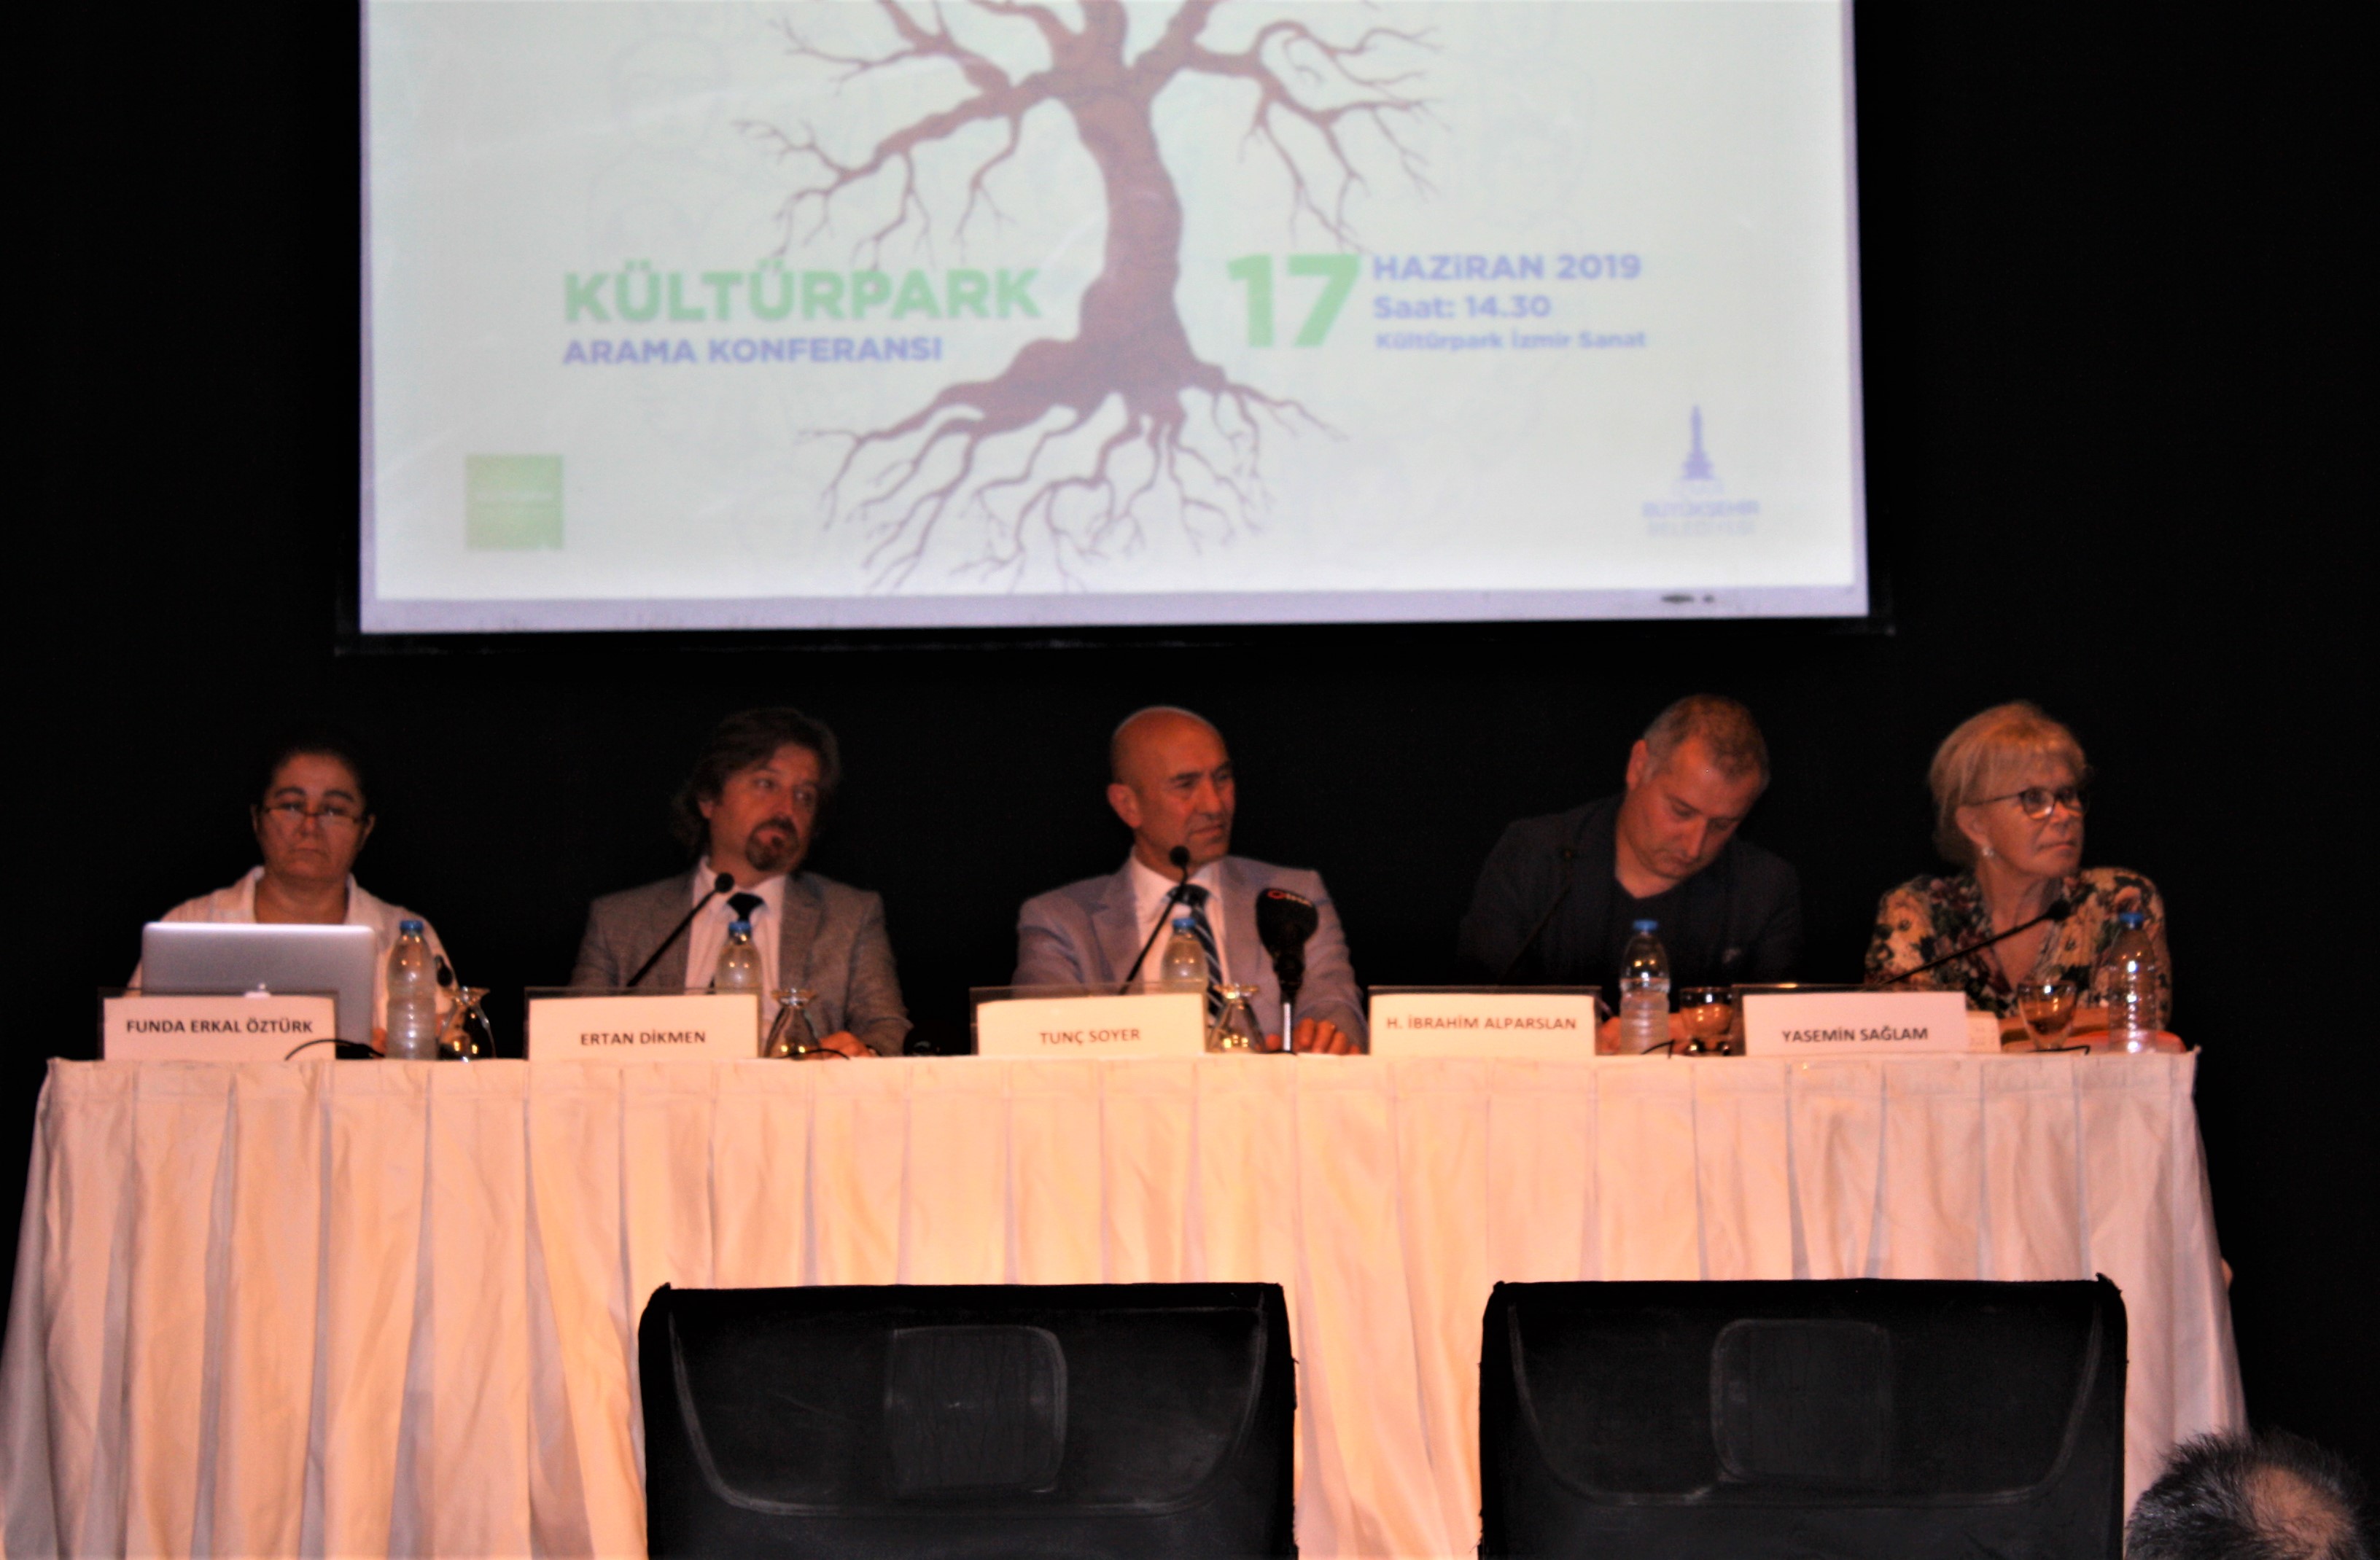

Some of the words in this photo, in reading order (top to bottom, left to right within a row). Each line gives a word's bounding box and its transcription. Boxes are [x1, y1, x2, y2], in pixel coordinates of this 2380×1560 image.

[1557, 254, 1641, 279] 2019
[563, 260, 1041, 323] KÜLTÜRPARK
[1227, 254, 1361, 348] 17
[1374, 295, 1455, 318] Saat:
[1465, 295, 1552, 317] 14.30
[563, 339, 697, 364] ARAMA
[709, 337, 942, 362] KONFERANSI
[1376, 330, 1502, 351] Kültürpark
[1579, 330, 1646, 348] Sanat
[125, 1019, 186, 1034] FUNDA
[190, 1019, 241, 1034] ERKAL
[246, 1017, 313, 1034] ÖZTÜRK
[1385, 1017, 1402, 1029] H.
[1407, 1015, 1479, 1030] İBRAHİM
[1484, 1017, 1577, 1030] ALPARSLAN
[580, 1032, 634, 1046] ERTAN
[639, 1029, 706, 1045] DİKMEN
[1039, 1030, 1084, 1046] TUNÇ
[1088, 1028, 1140, 1043] SOYER
[1781, 1027, 1856, 1043] YASEMİN
[1859, 1025, 1929, 1042] SAĞLAM
